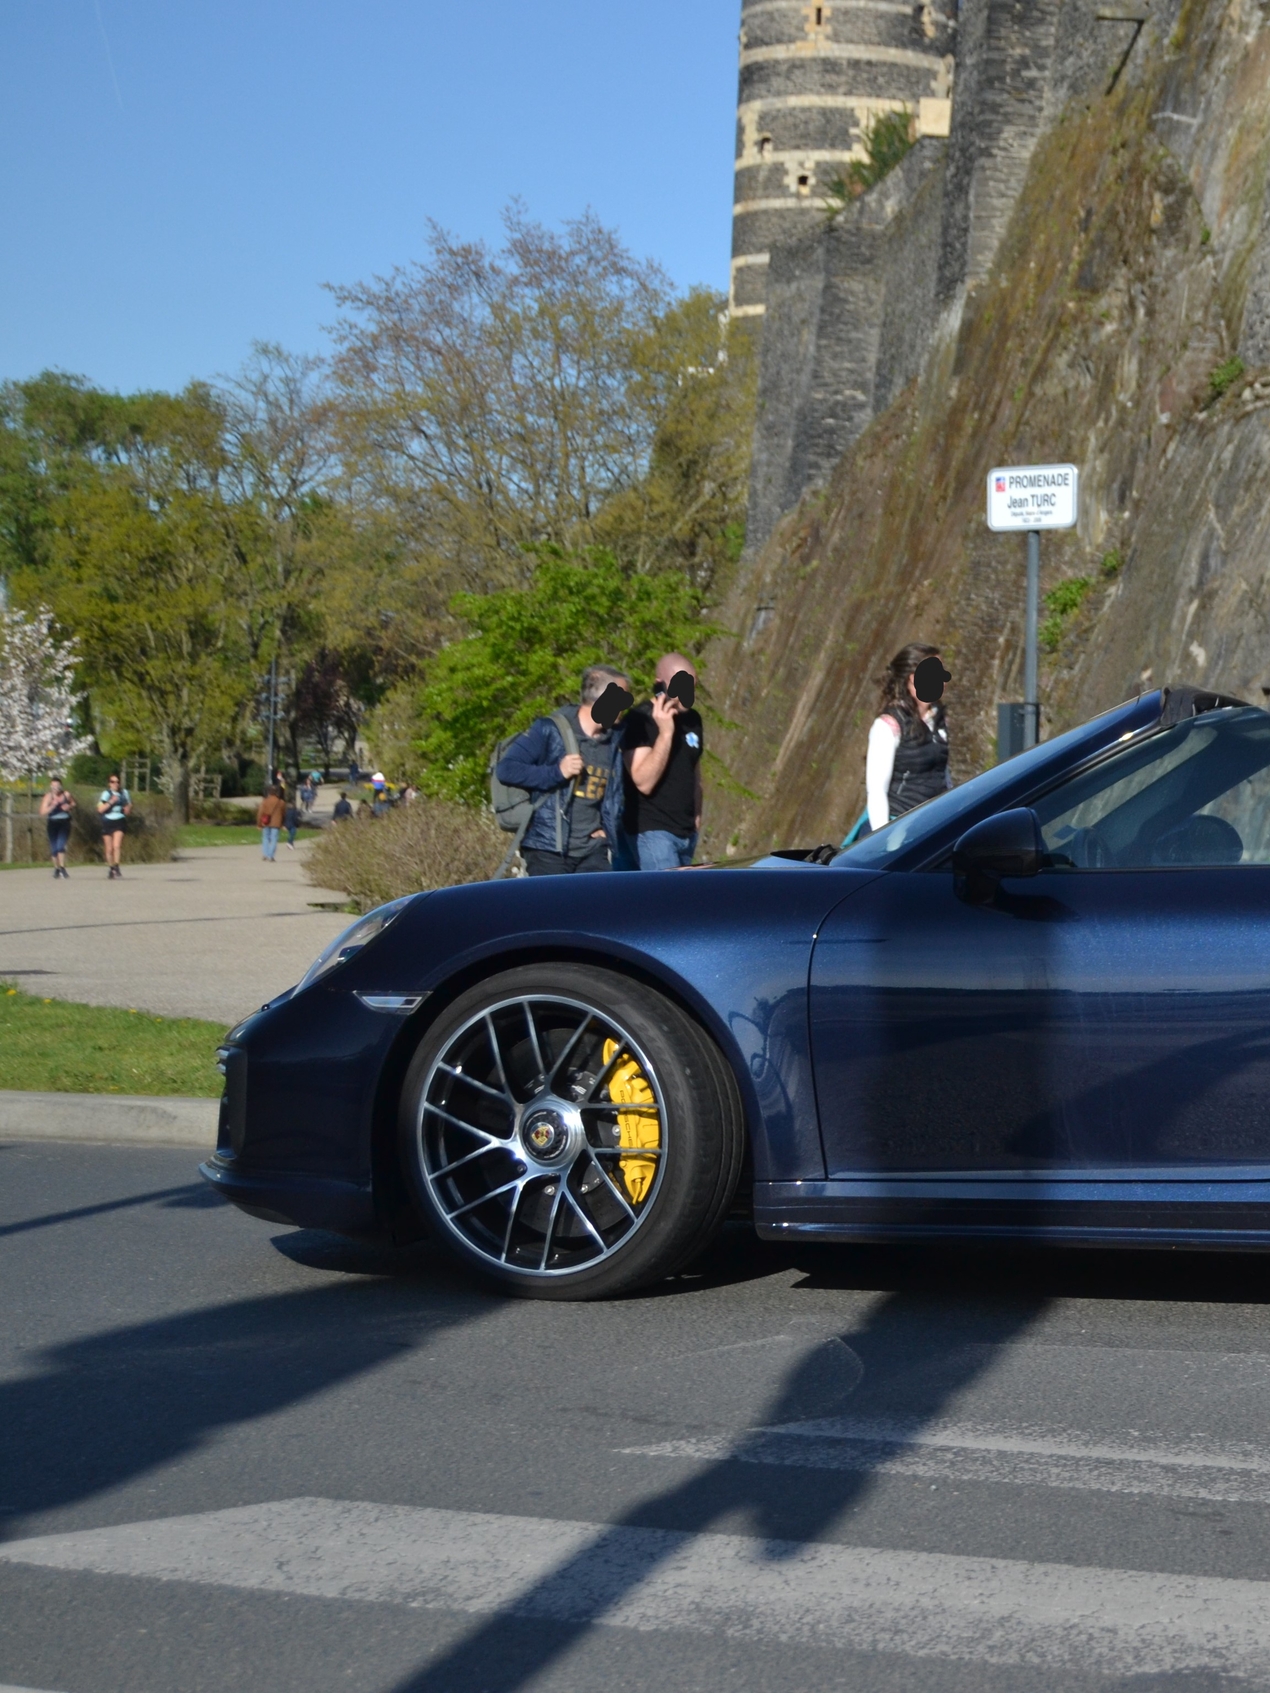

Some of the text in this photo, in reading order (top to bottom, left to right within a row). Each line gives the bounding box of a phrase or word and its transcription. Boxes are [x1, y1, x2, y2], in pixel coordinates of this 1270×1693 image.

[1009, 473, 1070, 489] PROMENADE
[1007, 493, 1056, 509] Jean TURC
